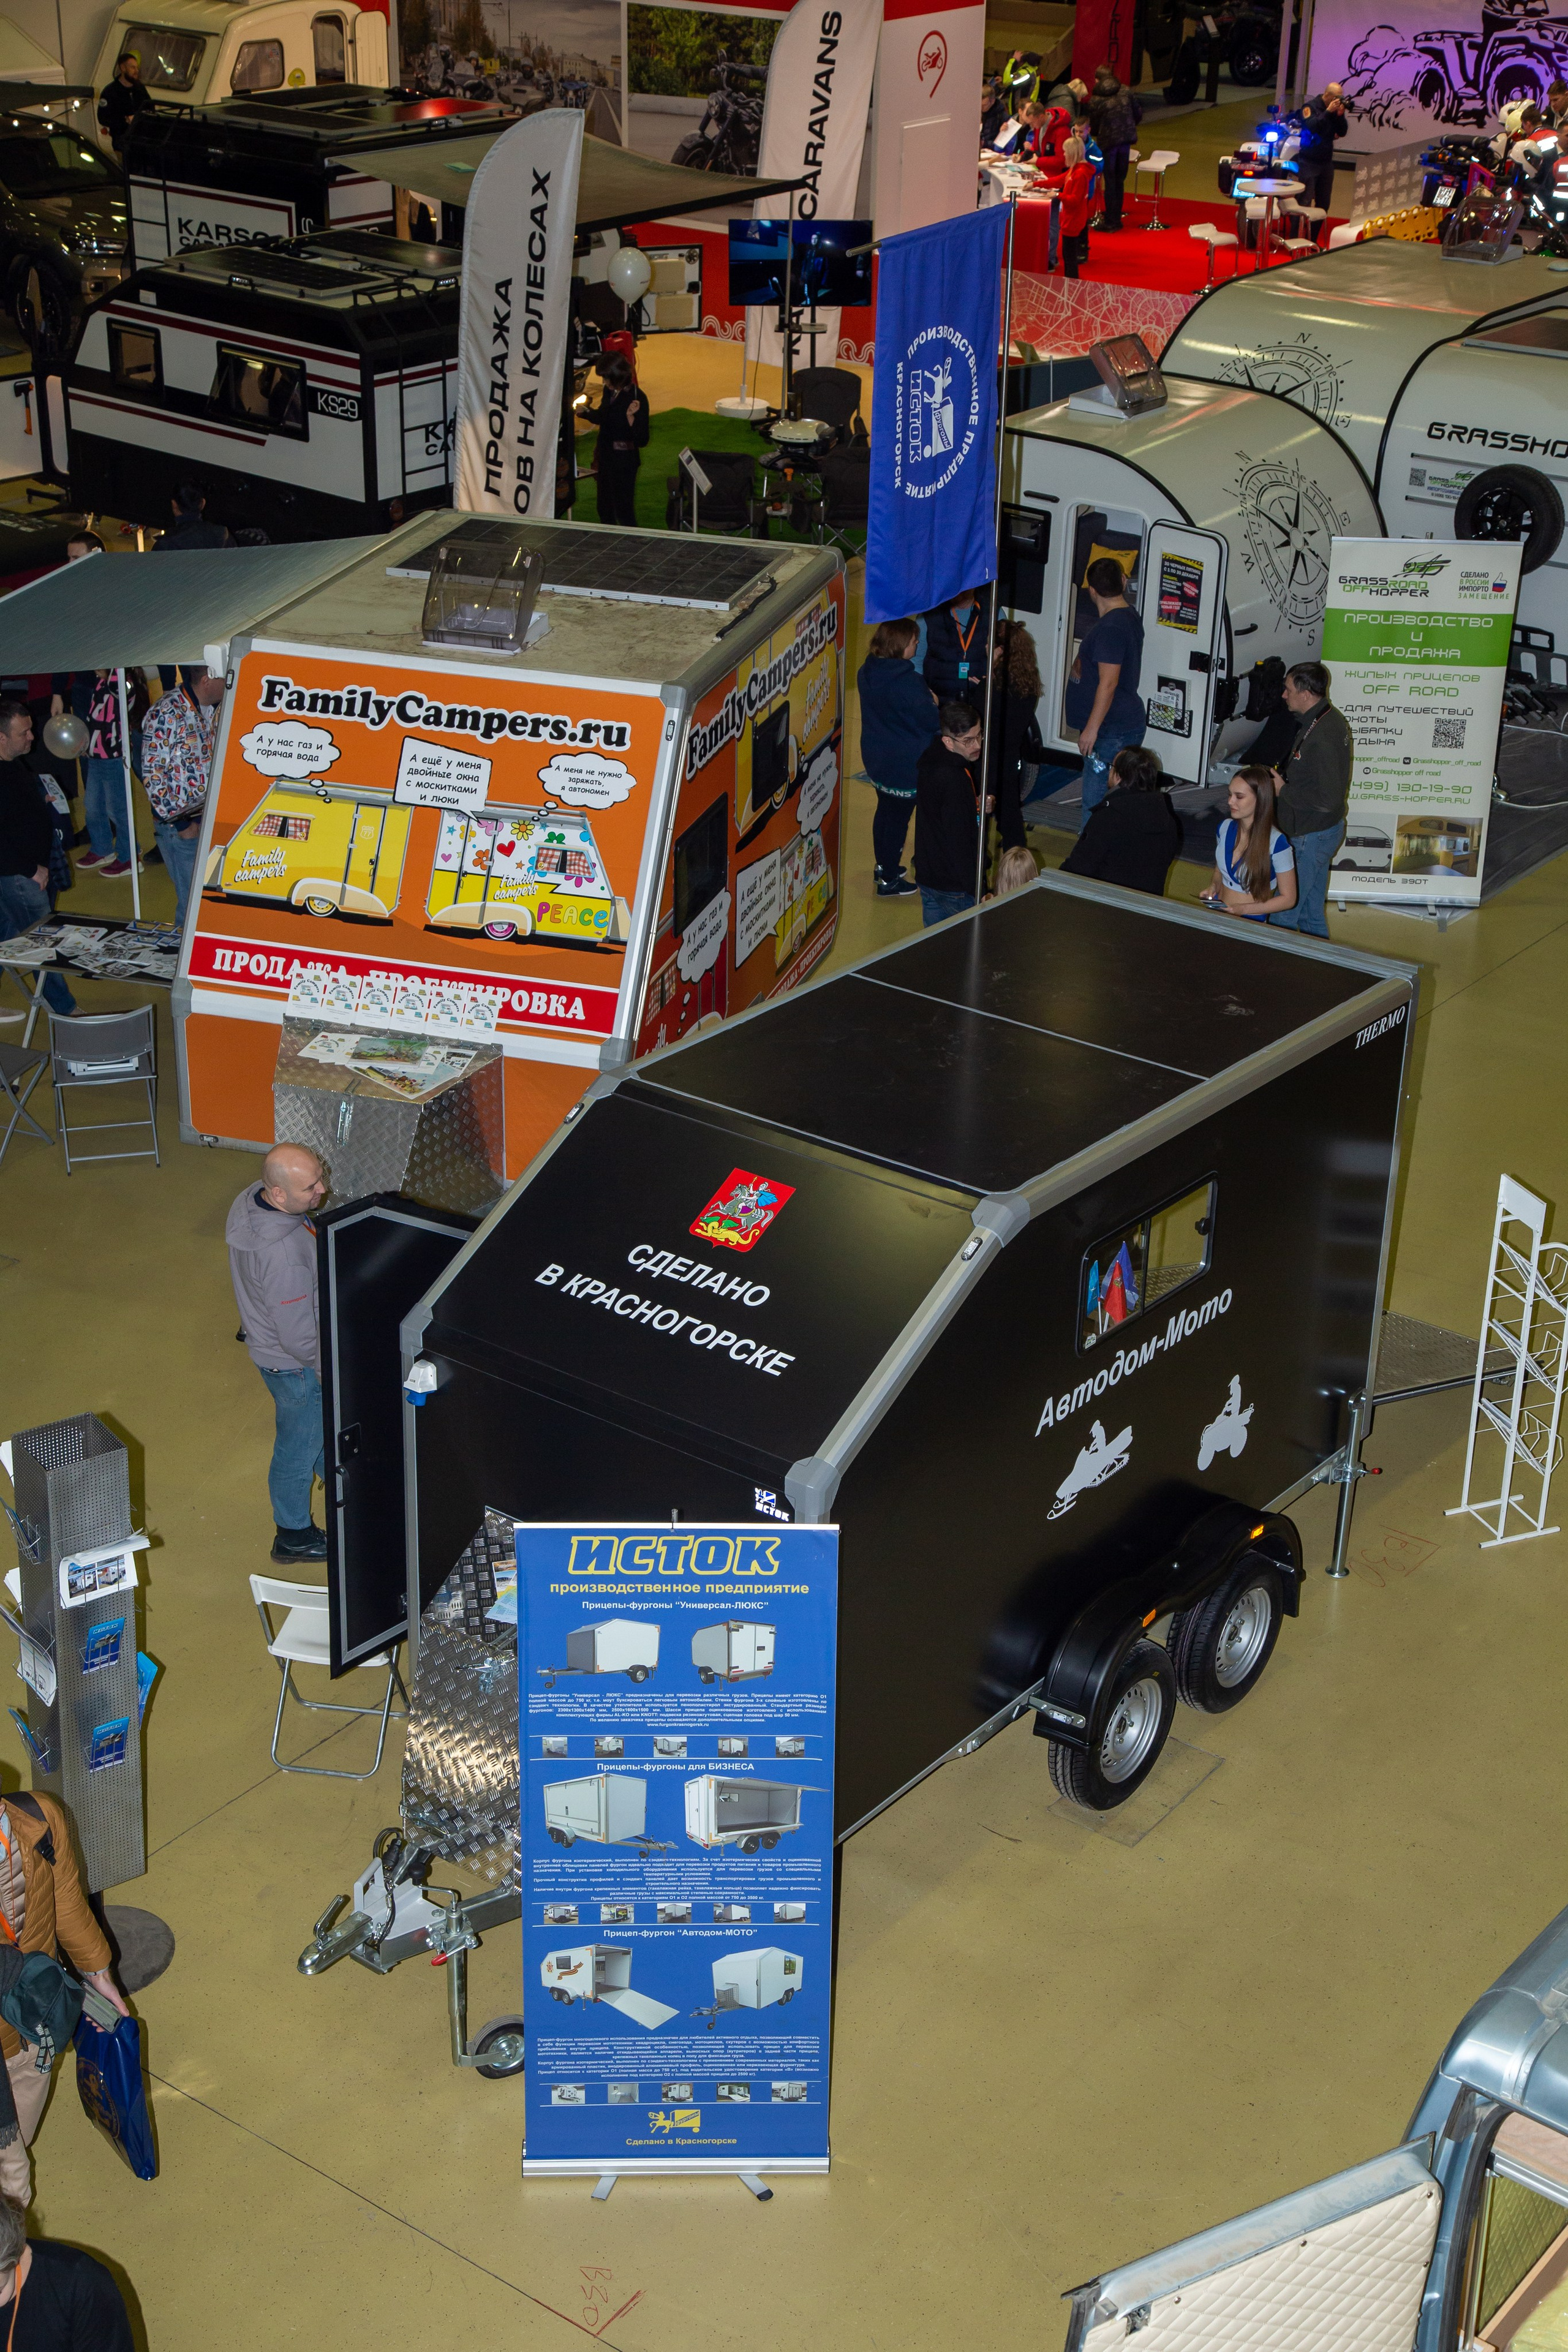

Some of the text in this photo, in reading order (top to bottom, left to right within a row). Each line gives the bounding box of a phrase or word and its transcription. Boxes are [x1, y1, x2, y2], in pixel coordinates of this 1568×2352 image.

[798, 11, 842, 220] CARAVANS
[522, 167, 551, 377] КОЛЕСАХ
[484, 277, 513, 497] ПРОДАЖА
[317, 392, 358, 419] KS29
[905, 325, 979, 499] ПРОИЗВОДСТВЕННОЕ ПРЕДПРИЯТИЕ
[518, 388, 538, 447] НА
[894, 361, 903, 489] КРАСНОГОРСК
[909, 369, 922, 464] ИСТОК
[1427, 421, 1568, 459] GRASSHO
[1339, 576, 1428, 589] GRASS ROAD
[1343, 584, 1430, 598] OFF HOPPER
[1344, 613, 1493, 628] ПРОИЗВОДСТВО
[1370, 646, 1461, 659] ПРОДАЖА
[1344, 670, 1480, 682] ЖИЛЫХ ПРИЦЕПОВ
[687, 601, 837, 780] FamilyCampers.ru
[1363, 685, 1459, 697] OFF ROAD
[260, 678, 628, 748] FamilyCampers.ru
[1378, 705, 1474, 716] ПУТЕШЕСТВИЙ
[257, 735, 263, 744] А
[268, 739, 273, 747] у
[277, 739, 293, 747] нас
[298, 741, 312, 750] газ
[257, 748, 319, 762] горячая вода
[410, 754, 481, 771] А ещё у меня
[407, 766, 480, 782] двойные окна
[564, 766, 582, 775] меня
[598, 769, 622, 779] нужно
[568, 776, 605, 787] заряжать,
[1372, 767, 1412, 776] Grasshopper
[415, 780, 477, 795] москитками
[568, 785, 610, 796] автономен
[881, 785, 911, 797] JEANS
[1397, 783, 1472, 794] 130-19-90
[431, 795, 459, 805] люки
[241, 846, 286, 869] Family
[233, 862, 288, 884] campers
[499, 870, 537, 887] Family
[747, 859, 777, 896] ещё меня
[494, 883, 538, 901] campers
[740, 877, 776, 921] двойные окна
[698, 908, 717, 932] нас газ
[745, 897, 776, 934] москитками
[687, 919, 722, 964] горячая вода
[753, 920, 768, 943] люки
[1354, 1006, 1406, 1050] THERMO
[627, 1243, 771, 1308] СДЕЛАНО
[535, 1264, 796, 1378] В КРАСНОГОРСКЕ
[1035, 1287, 1232, 1438] Автодом-Мото
[755, 1502, 790, 1522] ИСТОК
[567, 1535, 782, 1575] ИСТОК
[550, 1583, 810, 1595] производственное предприятие
[582, 1601, 673, 1610] Прицепы-фургоны
